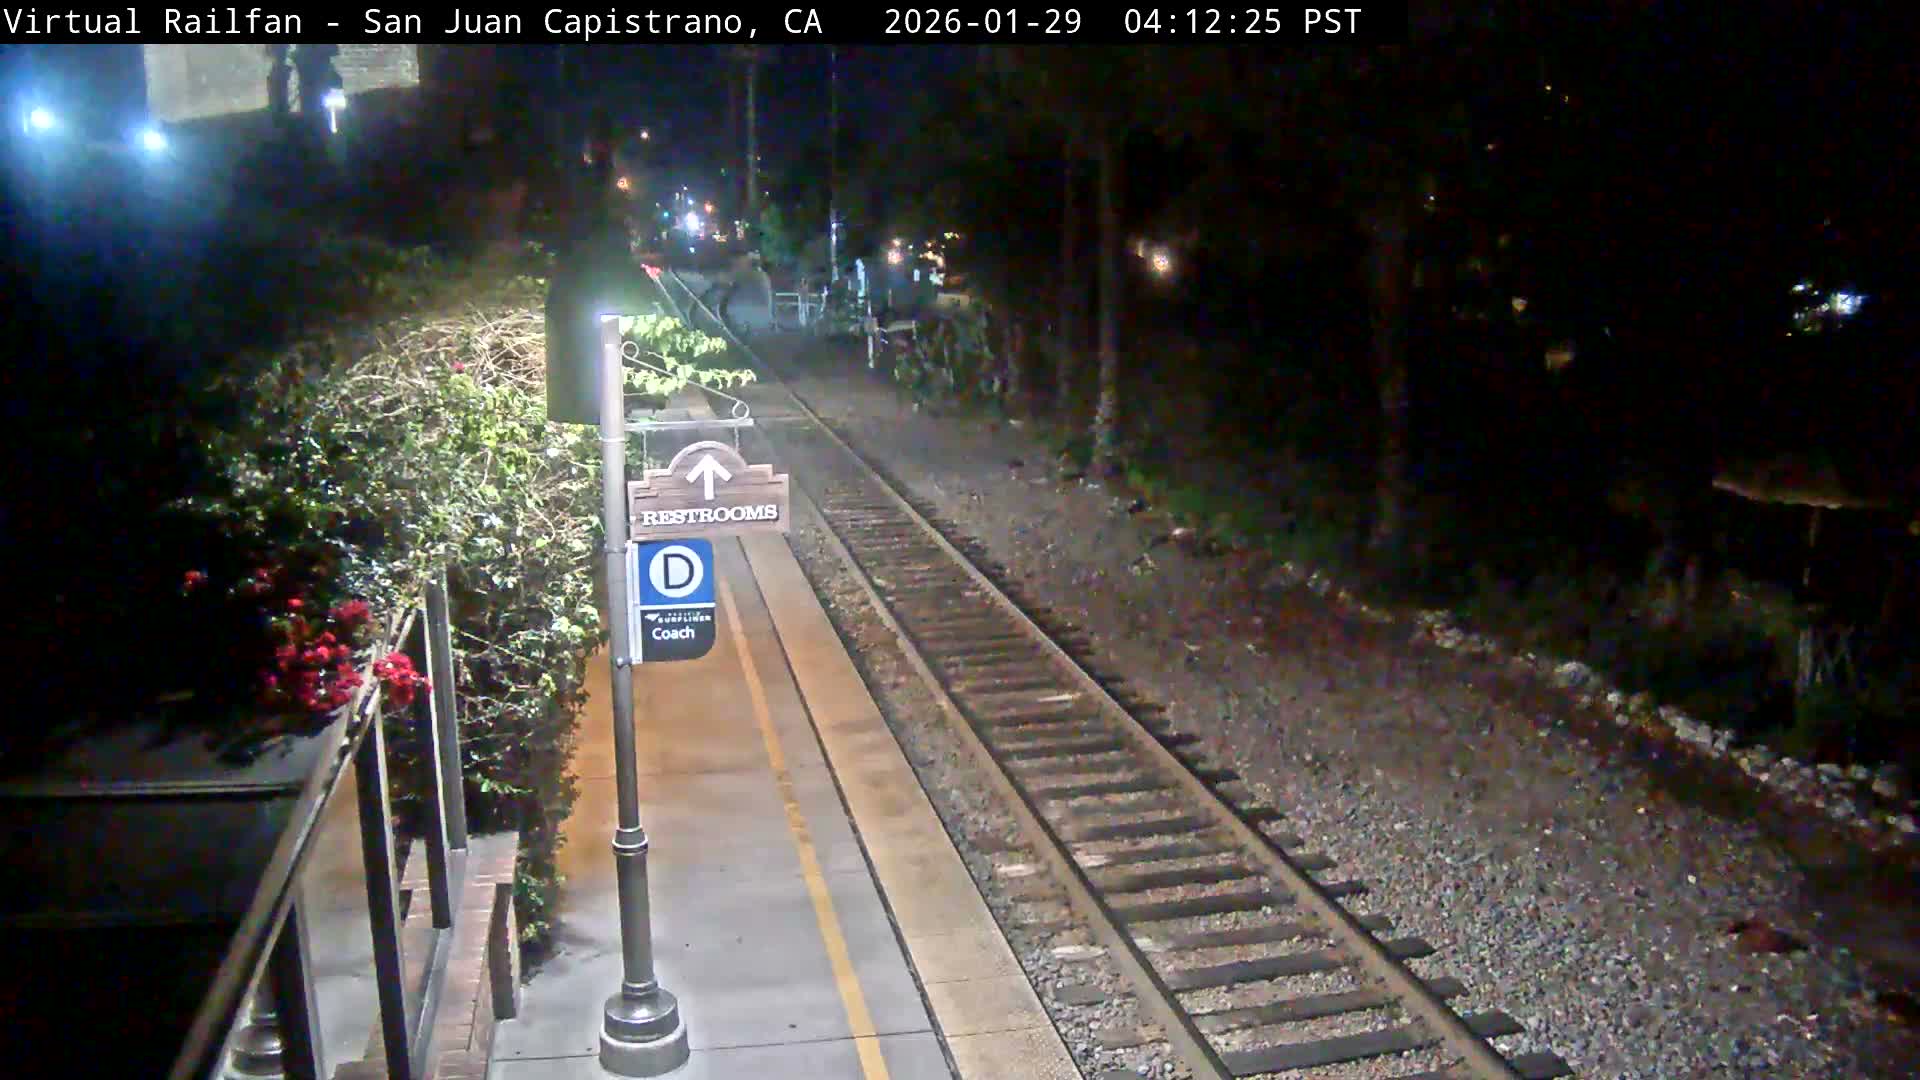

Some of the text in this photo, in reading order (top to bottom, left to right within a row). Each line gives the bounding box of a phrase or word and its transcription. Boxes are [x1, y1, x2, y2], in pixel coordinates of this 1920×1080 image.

[641, 504, 778, 527] RESTROOMS
[663, 553, 695, 590] D
[651, 625, 695, 641] Coach
